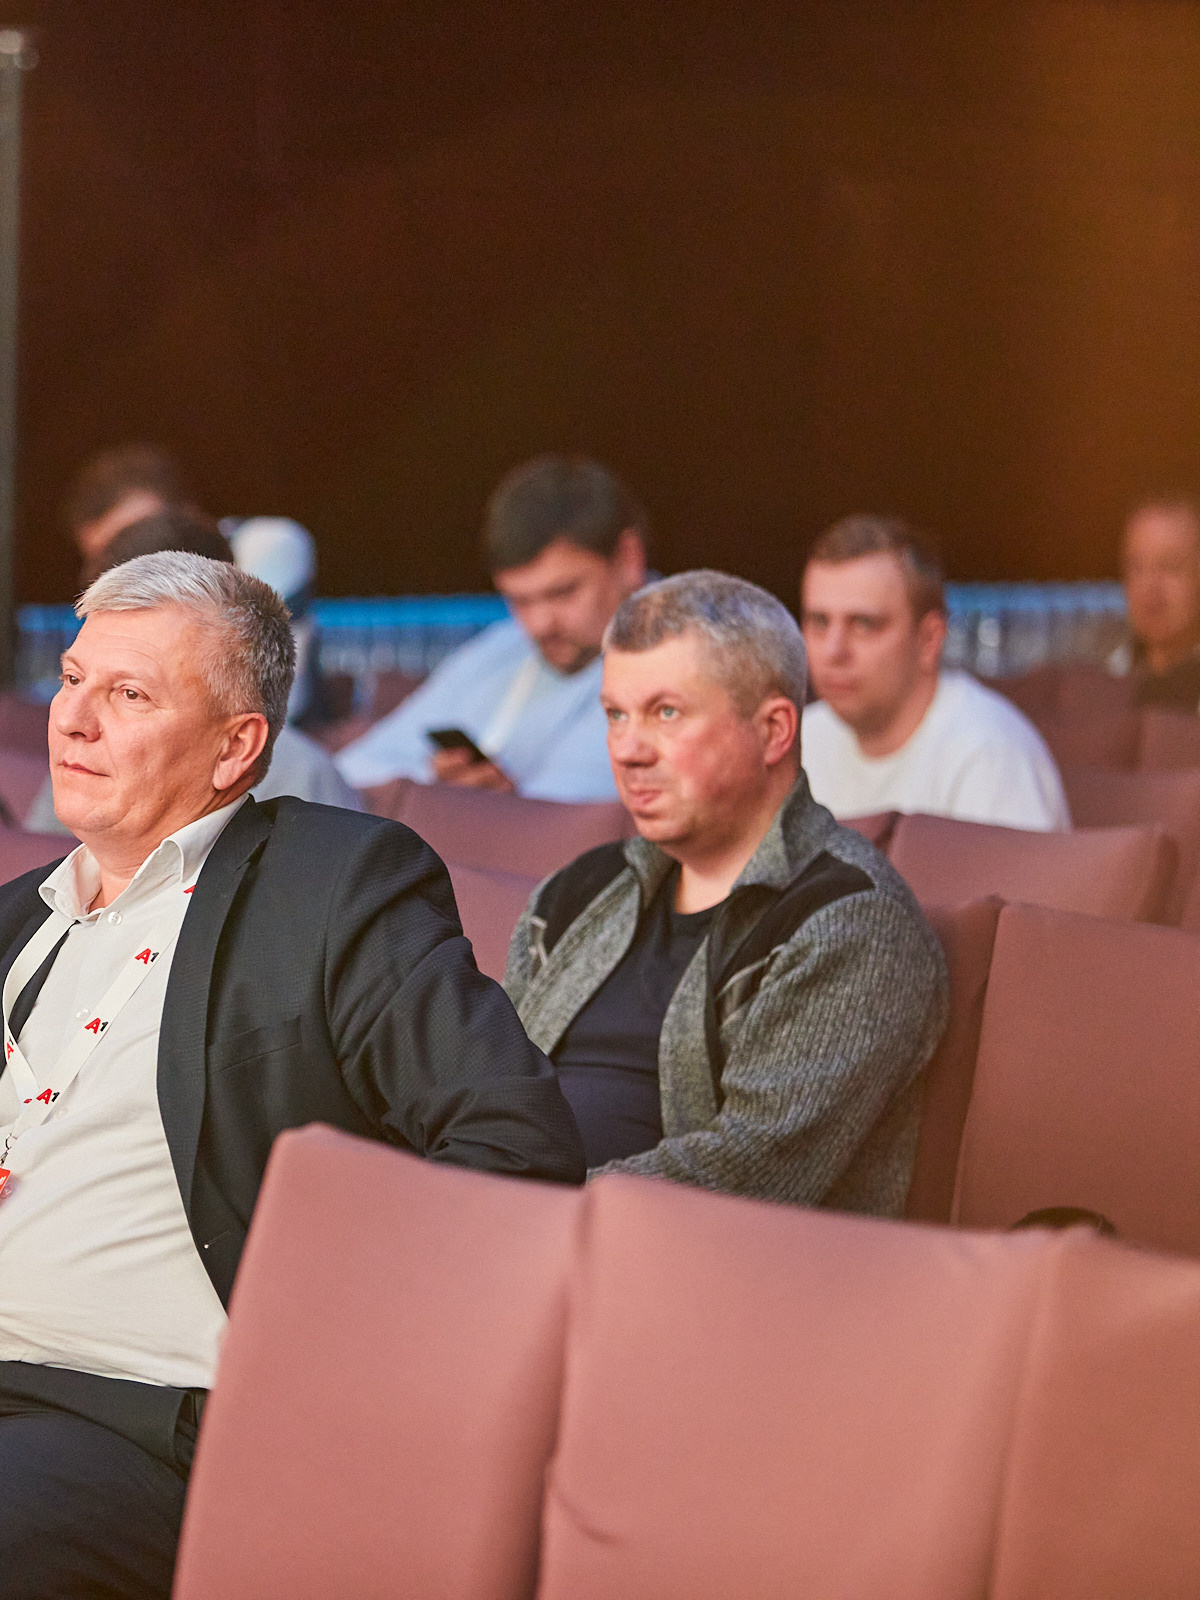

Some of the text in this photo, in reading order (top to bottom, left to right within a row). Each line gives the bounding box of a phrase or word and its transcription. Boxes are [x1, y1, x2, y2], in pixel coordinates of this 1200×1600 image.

[135, 948, 159, 965] A1
[84, 1017, 109, 1034] A1
[36, 1088, 60, 1105] A1
